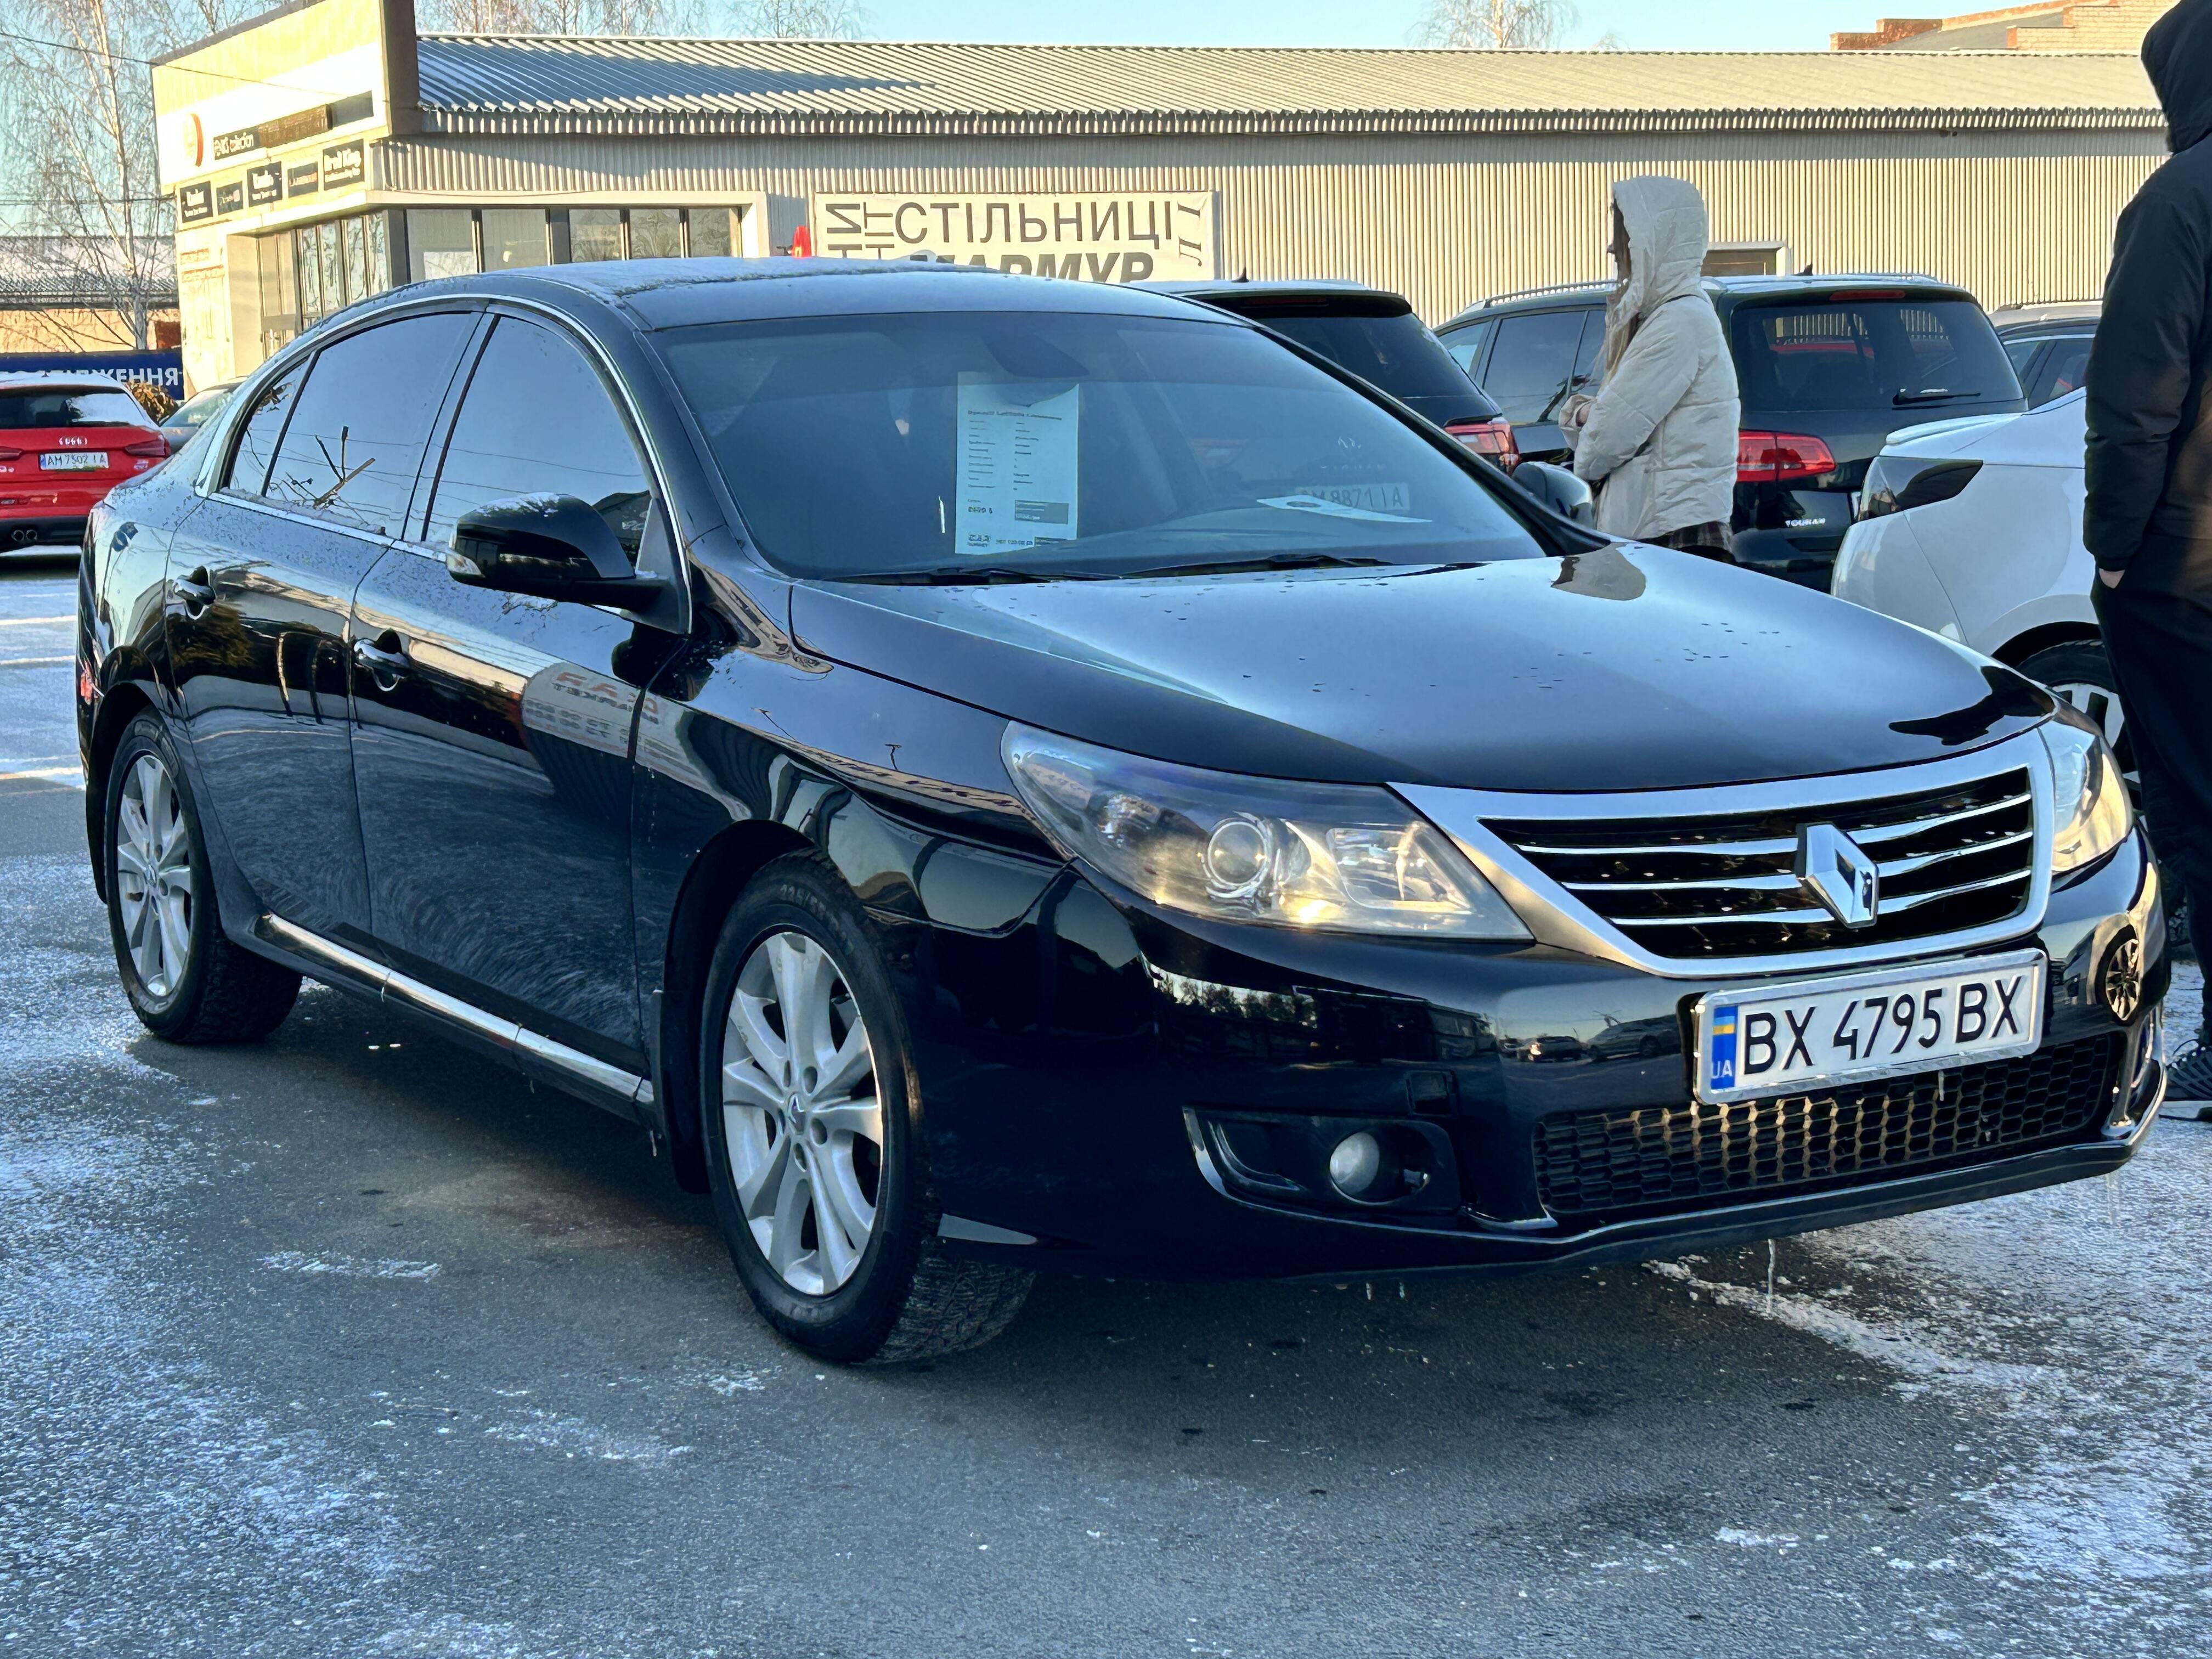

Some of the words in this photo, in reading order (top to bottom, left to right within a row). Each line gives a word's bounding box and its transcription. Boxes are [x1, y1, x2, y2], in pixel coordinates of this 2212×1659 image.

[895, 201, 1172, 250] СТІЛЬНИЦІ
[1743, 1006, 1816, 1075] BX
[1832, 989, 1944, 1061] 4795
[1955, 976, 2022, 1044] BX
[1711, 1059, 1733, 1079] UA
